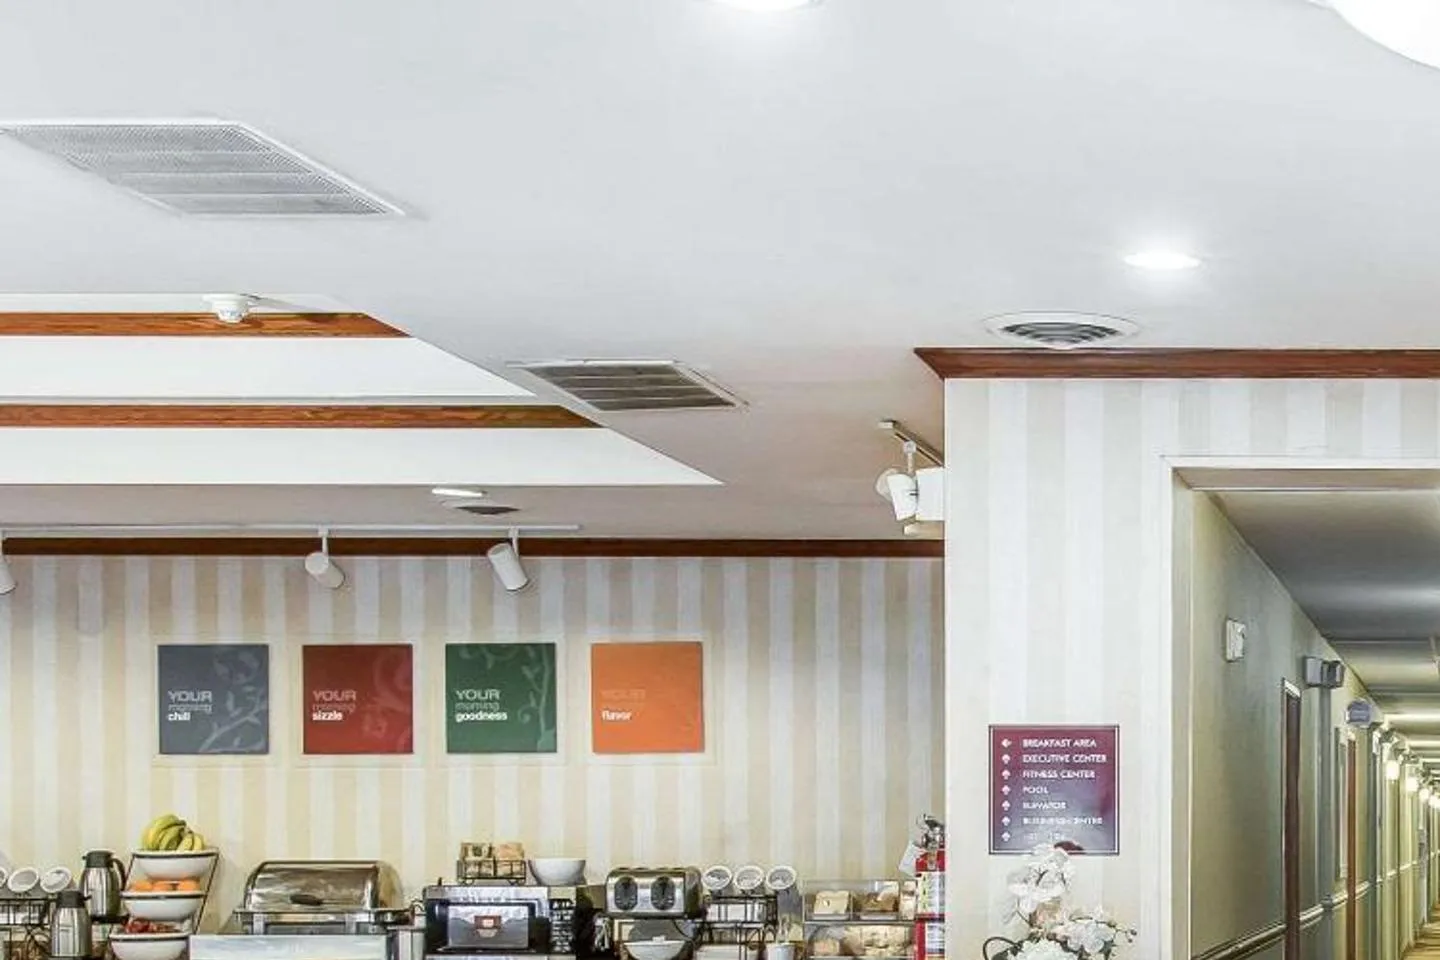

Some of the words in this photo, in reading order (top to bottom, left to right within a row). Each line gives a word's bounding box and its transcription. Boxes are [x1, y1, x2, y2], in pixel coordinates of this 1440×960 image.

[167, 690, 213, 702] YOUR
[313, 690, 357, 701] YOUR
[456, 689, 500, 700] YOUR
[312, 710, 343, 721] sizzle
[455, 711, 508, 723] goodness
[1022, 739, 1072, 748] BREAKFAST
[1073, 739, 1097, 748] AREA
[1022, 754, 1071, 763] EXECUTIVE
[1073, 754, 1107, 763] CENTER
[1022, 770, 1058, 779] FITNESS
[1061, 770, 1096, 779] CENTER
[1022, 786, 1049, 794] POOL
